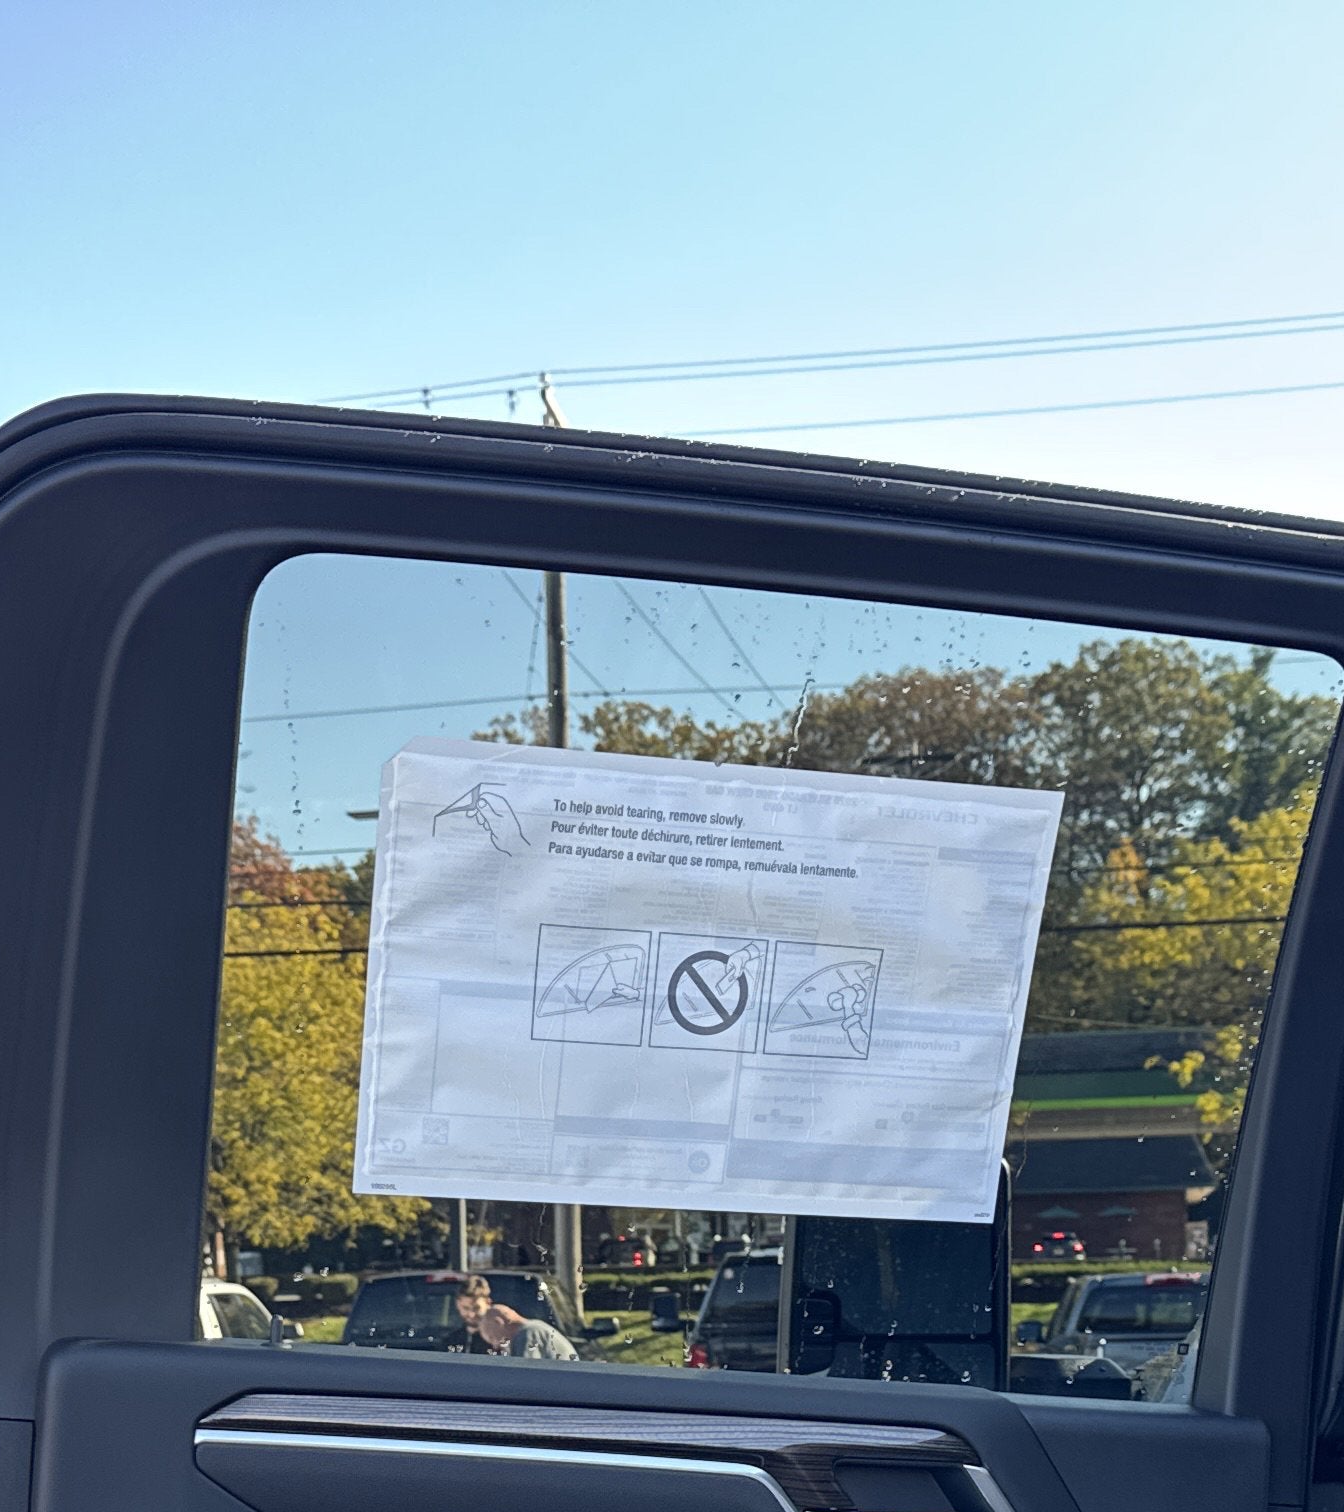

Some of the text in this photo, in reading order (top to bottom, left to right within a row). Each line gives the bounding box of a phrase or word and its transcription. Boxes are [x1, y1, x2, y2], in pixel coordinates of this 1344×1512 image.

[554, 799, 746, 829] To help avoid tearing, remove slowly.
[550, 820, 785, 852] Pour éviter toute déchirure, retirer lentement.
[548, 842, 859, 879] Para ayudarse a evitar que se rompa, remuévala lentamente.
